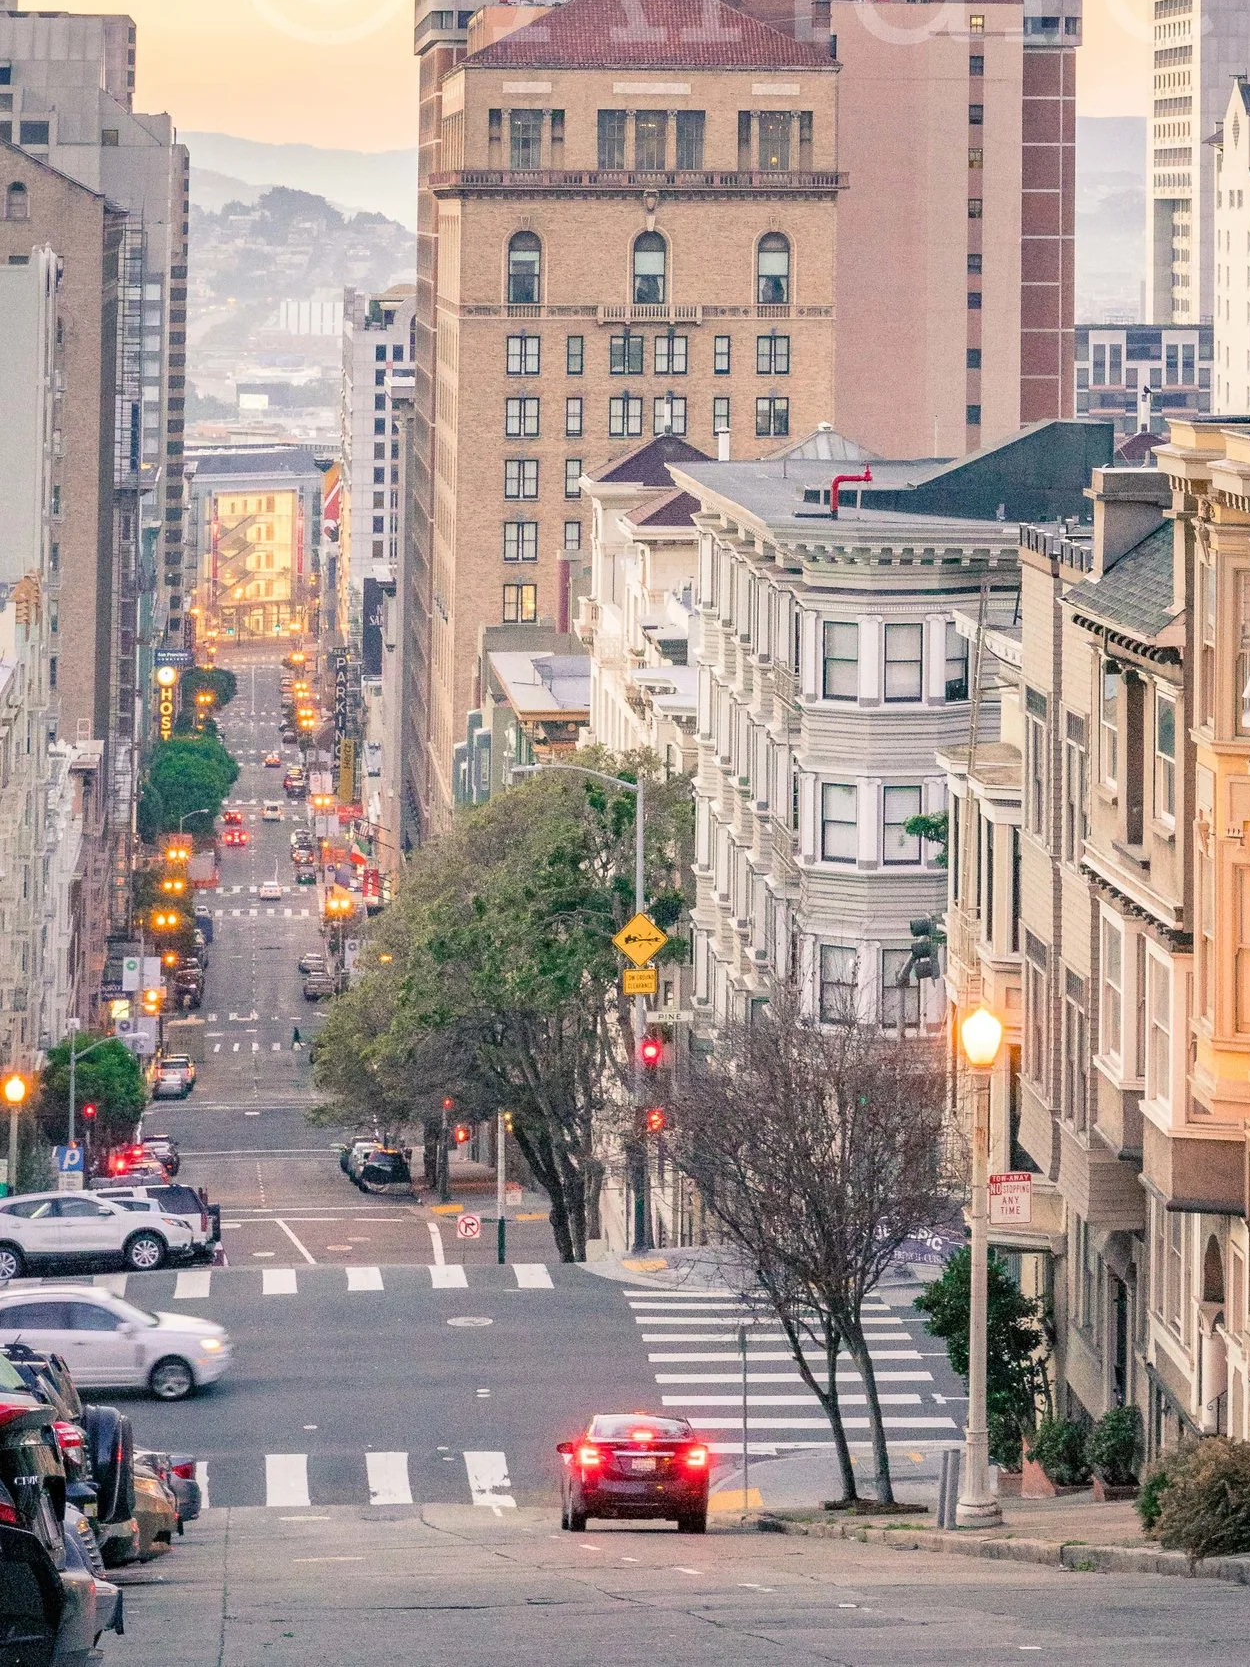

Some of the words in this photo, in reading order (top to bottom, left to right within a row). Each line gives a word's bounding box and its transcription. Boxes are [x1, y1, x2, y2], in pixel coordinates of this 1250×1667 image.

[63, 1149, 81, 1170] P
[991, 1174, 1029, 1182] TOW-AWAY
[990, 1183, 1001, 1194] NO
[1003, 1184, 1029, 1193] STOPPING
[1002, 1196, 1019, 1204] ANY
[1001, 1206, 1020, 1214] TIME
